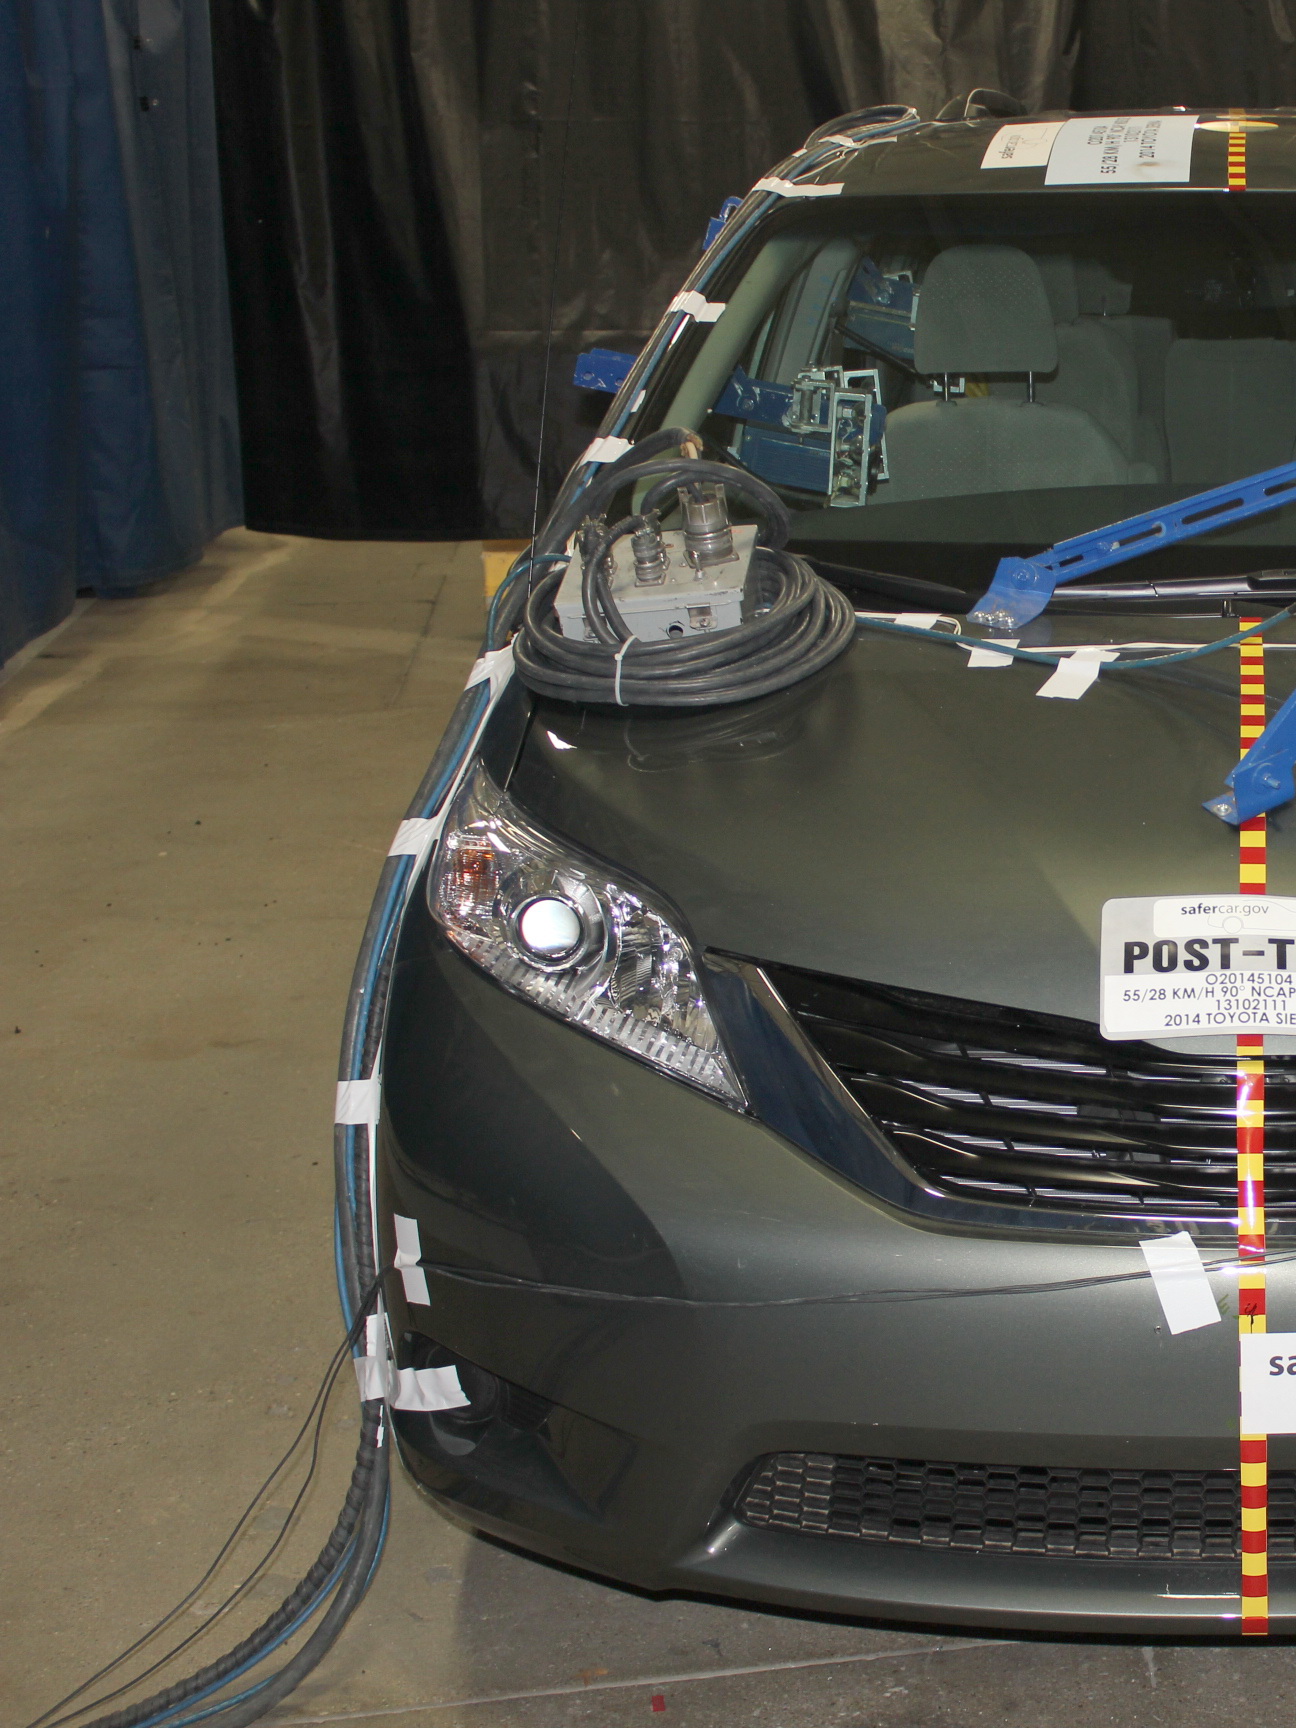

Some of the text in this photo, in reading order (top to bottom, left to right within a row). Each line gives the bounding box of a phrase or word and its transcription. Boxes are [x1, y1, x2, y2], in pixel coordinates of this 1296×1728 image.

[1181, 903, 1269, 916] safercar.gov
[1123, 988, 1167, 1003] 55/28
[1173, 986, 1214, 1000] KM/H
[1251, 986, 1296, 999] NCAP
[1216, 999, 1286, 1010] 13102111
[1164, 1014, 1200, 1027] 2014
[1206, 1012, 1269, 1025] TOYOTA
